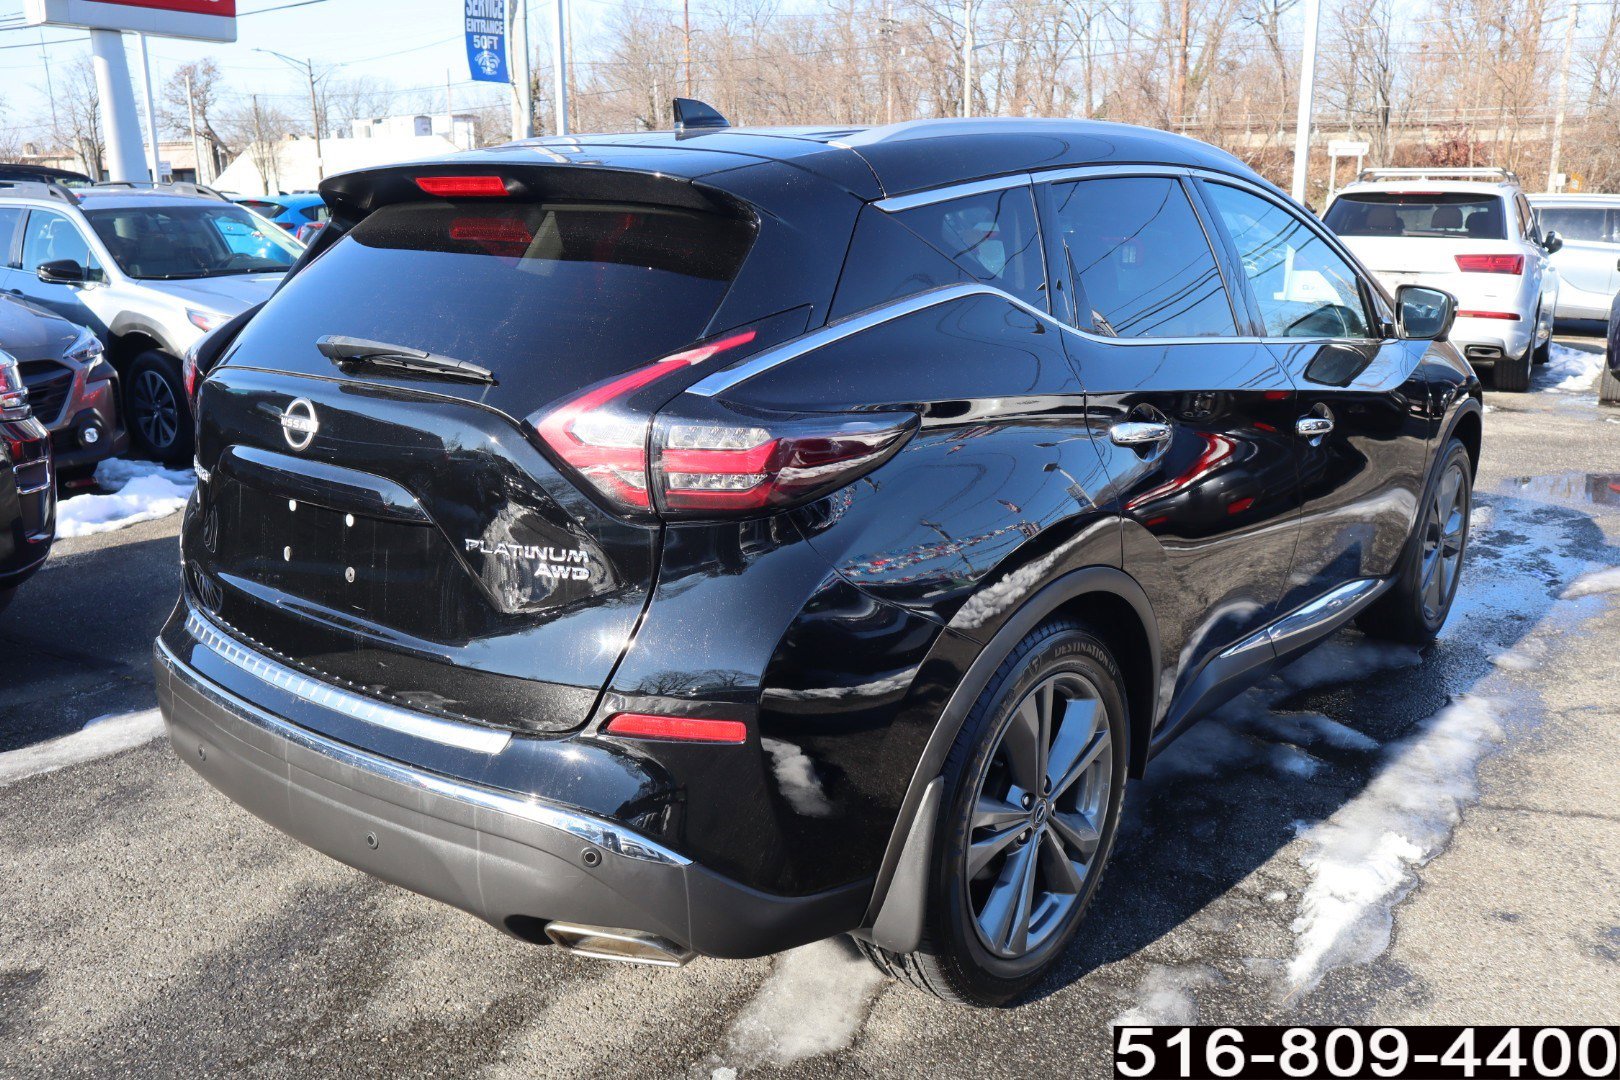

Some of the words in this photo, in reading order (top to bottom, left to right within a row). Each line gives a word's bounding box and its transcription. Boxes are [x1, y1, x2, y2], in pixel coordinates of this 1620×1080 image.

[465, 0, 504, 19] SERVICE
[466, 17, 504, 35] ENTRANCE
[473, 35, 499, 50] 50FT
[464, 538, 590, 563] PLATINUM
[533, 562, 591, 580] AWD
[1054, 641, 1109, 667] DESTINATION
